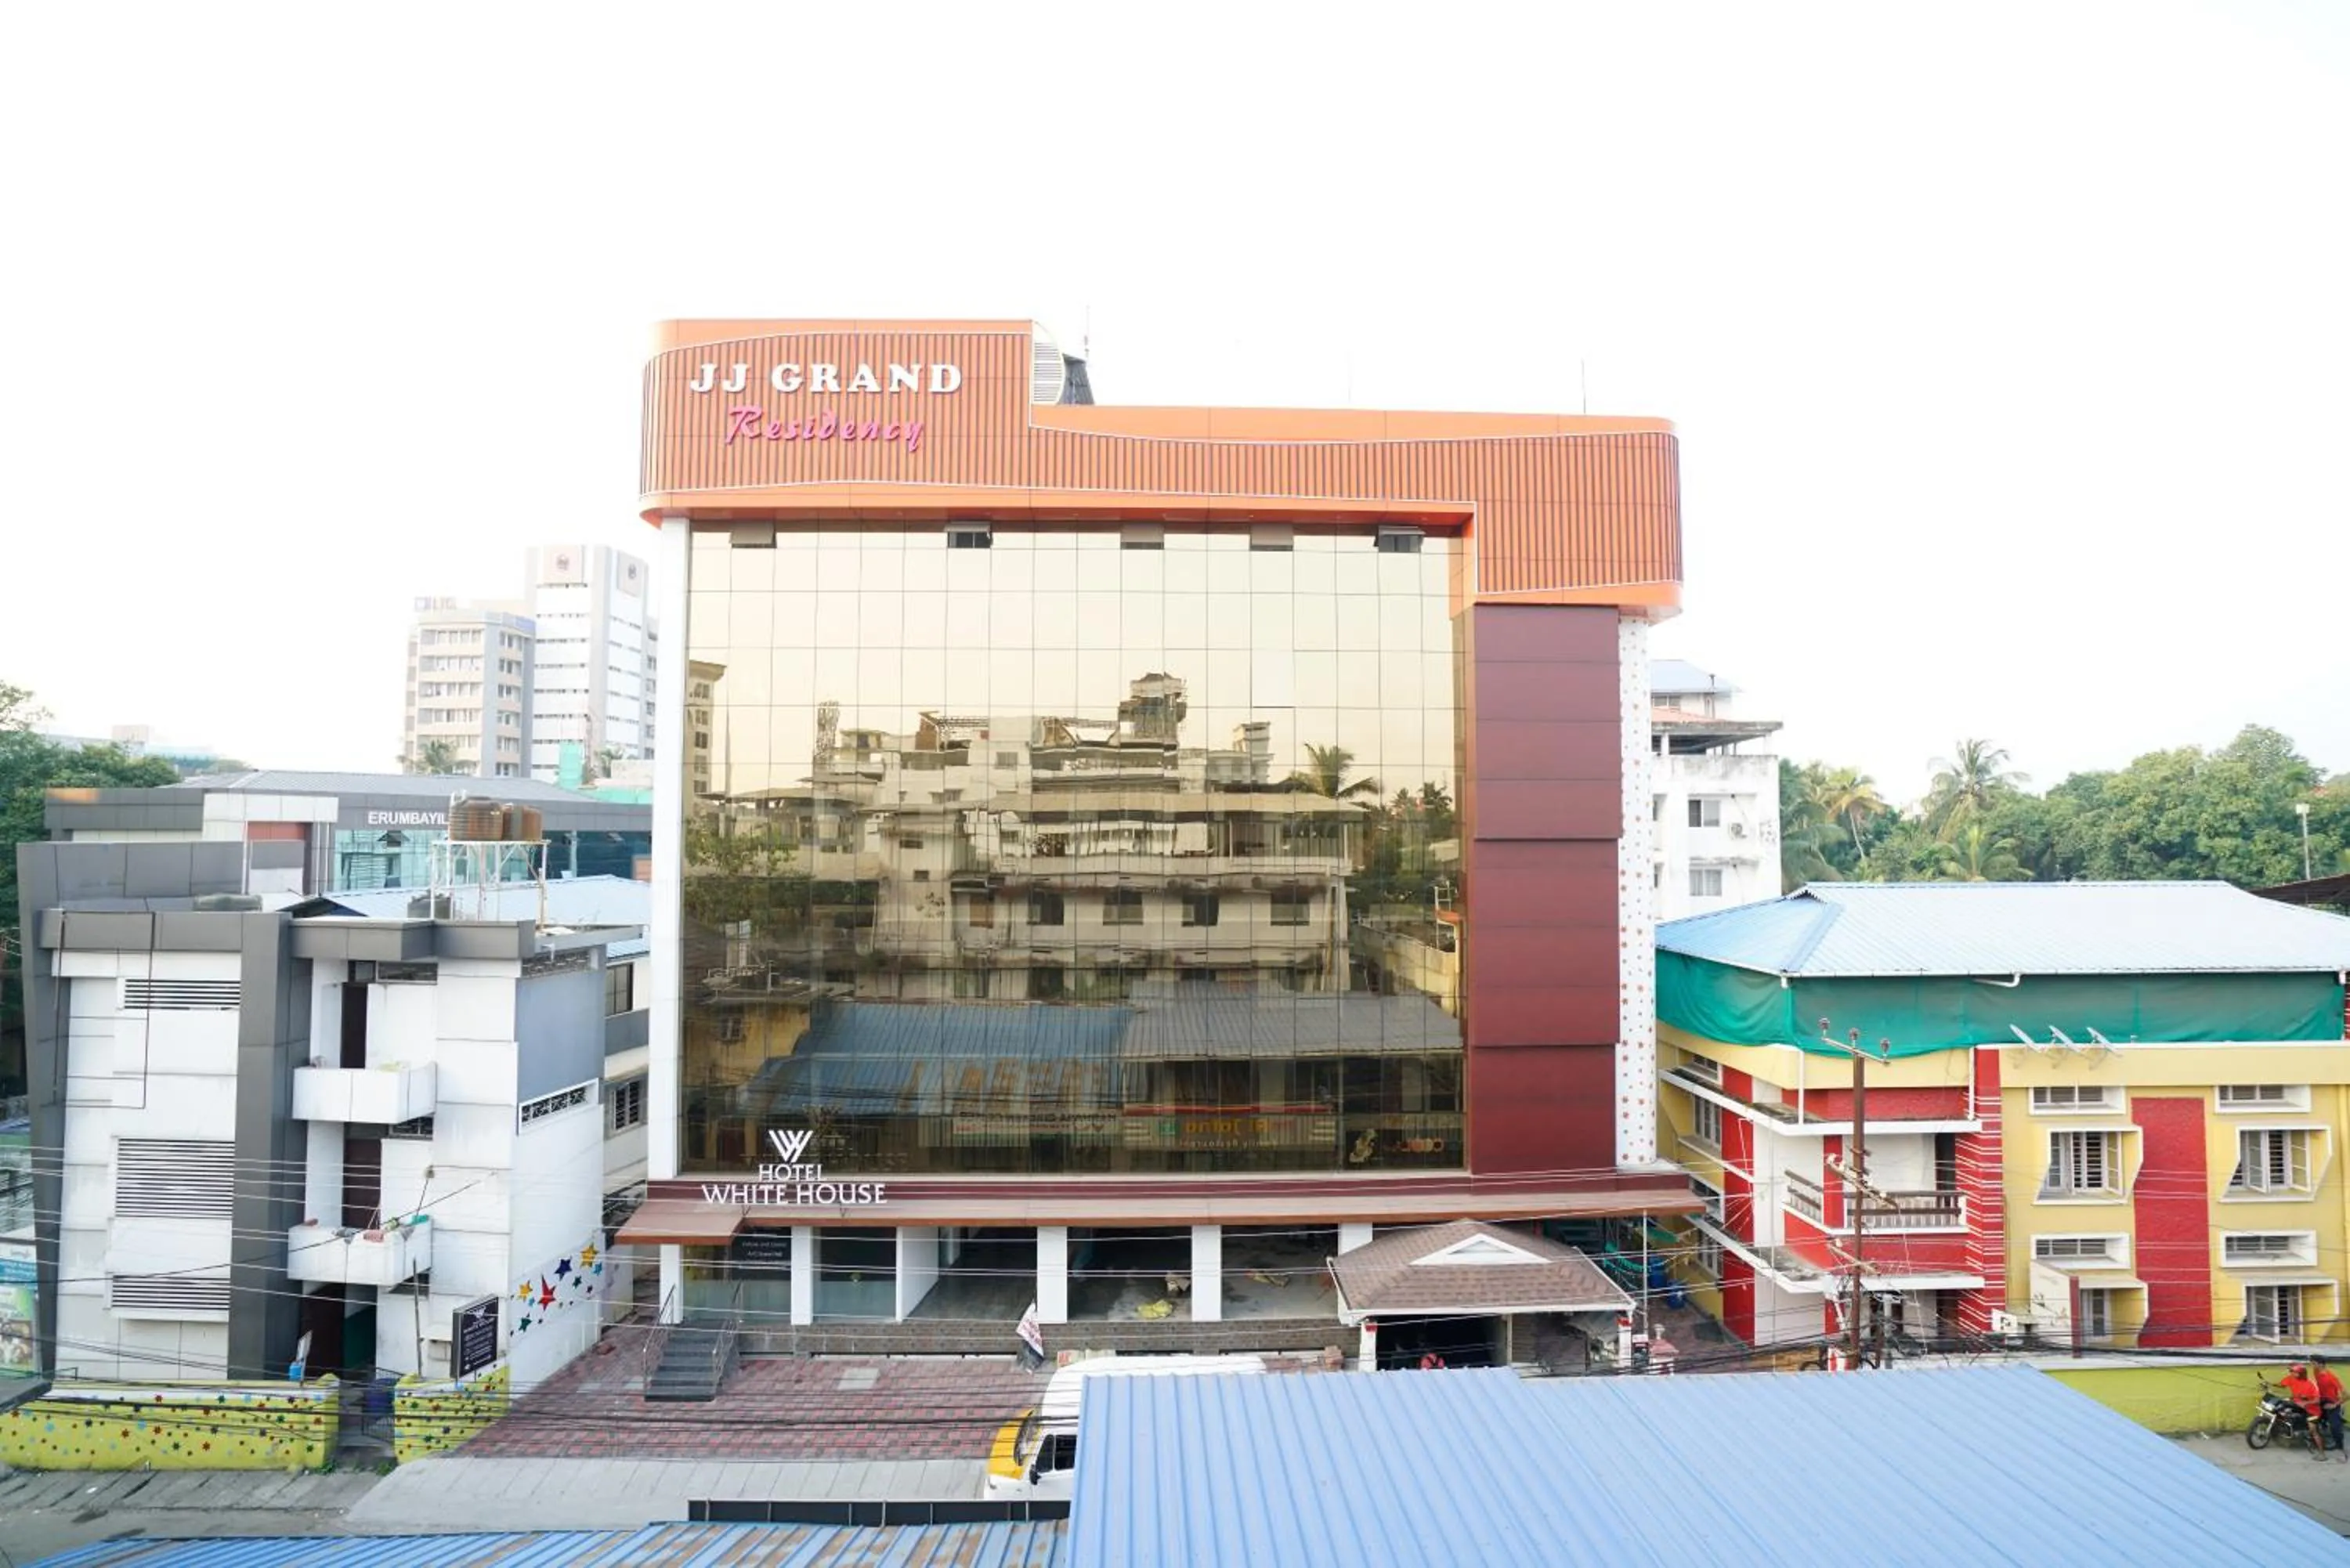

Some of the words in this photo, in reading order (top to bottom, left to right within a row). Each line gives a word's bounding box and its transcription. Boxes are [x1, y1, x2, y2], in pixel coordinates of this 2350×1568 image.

[690, 363, 750, 393] JJ
[770, 363, 963, 393] GRAND
[725, 405, 925, 453] Residency
[367, 811, 450, 825] ERUMBAYIL
[757, 1163, 827, 1182] HOTEL
[701, 1183, 790, 1205] WHITE
[797, 1183, 888, 1205] HOUSE
